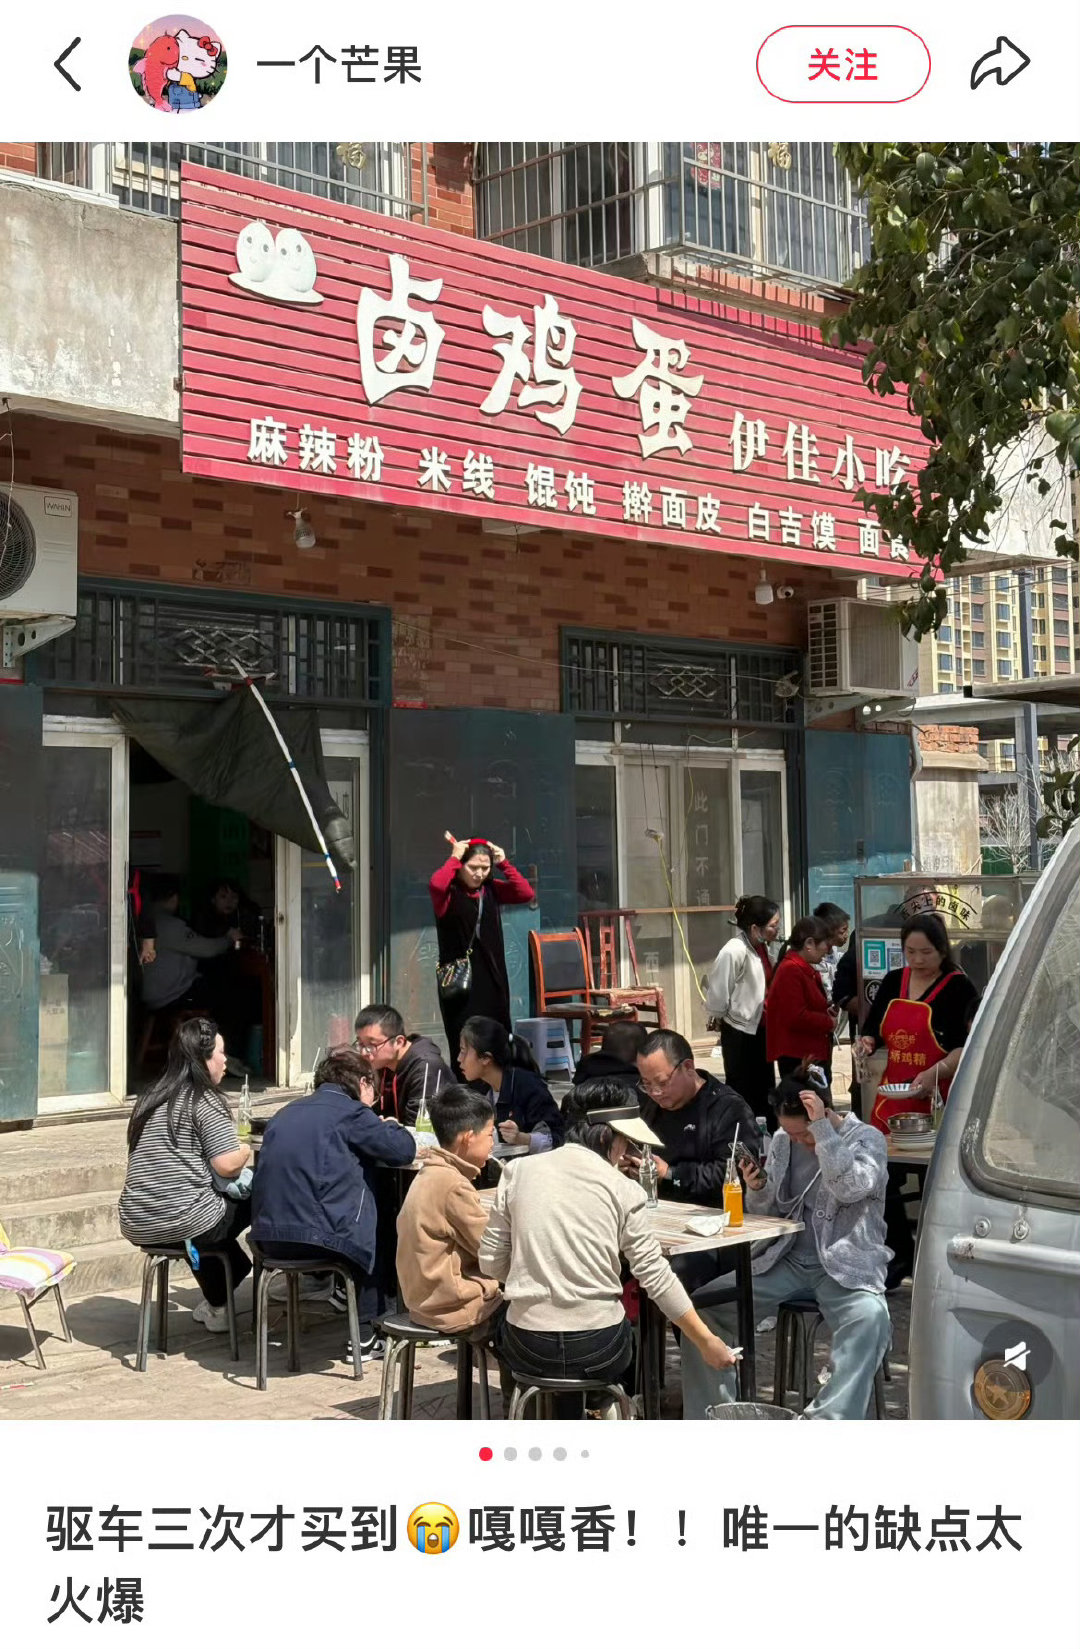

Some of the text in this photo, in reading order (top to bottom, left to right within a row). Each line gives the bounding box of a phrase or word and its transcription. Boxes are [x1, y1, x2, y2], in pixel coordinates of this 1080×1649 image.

[356, 253, 704, 460] 卤鸡蛋
[247, 416, 385, 480] 麻辣粉
[418, 446, 495, 499] 米线
[525, 462, 597, 515] 馄饨
[622, 480, 722, 533] 擀面皮
[748, 502, 836, 551] 白吉馍
[729, 411, 911, 494] 伊佳小吃
[693, 790, 712, 906] 此门不通
